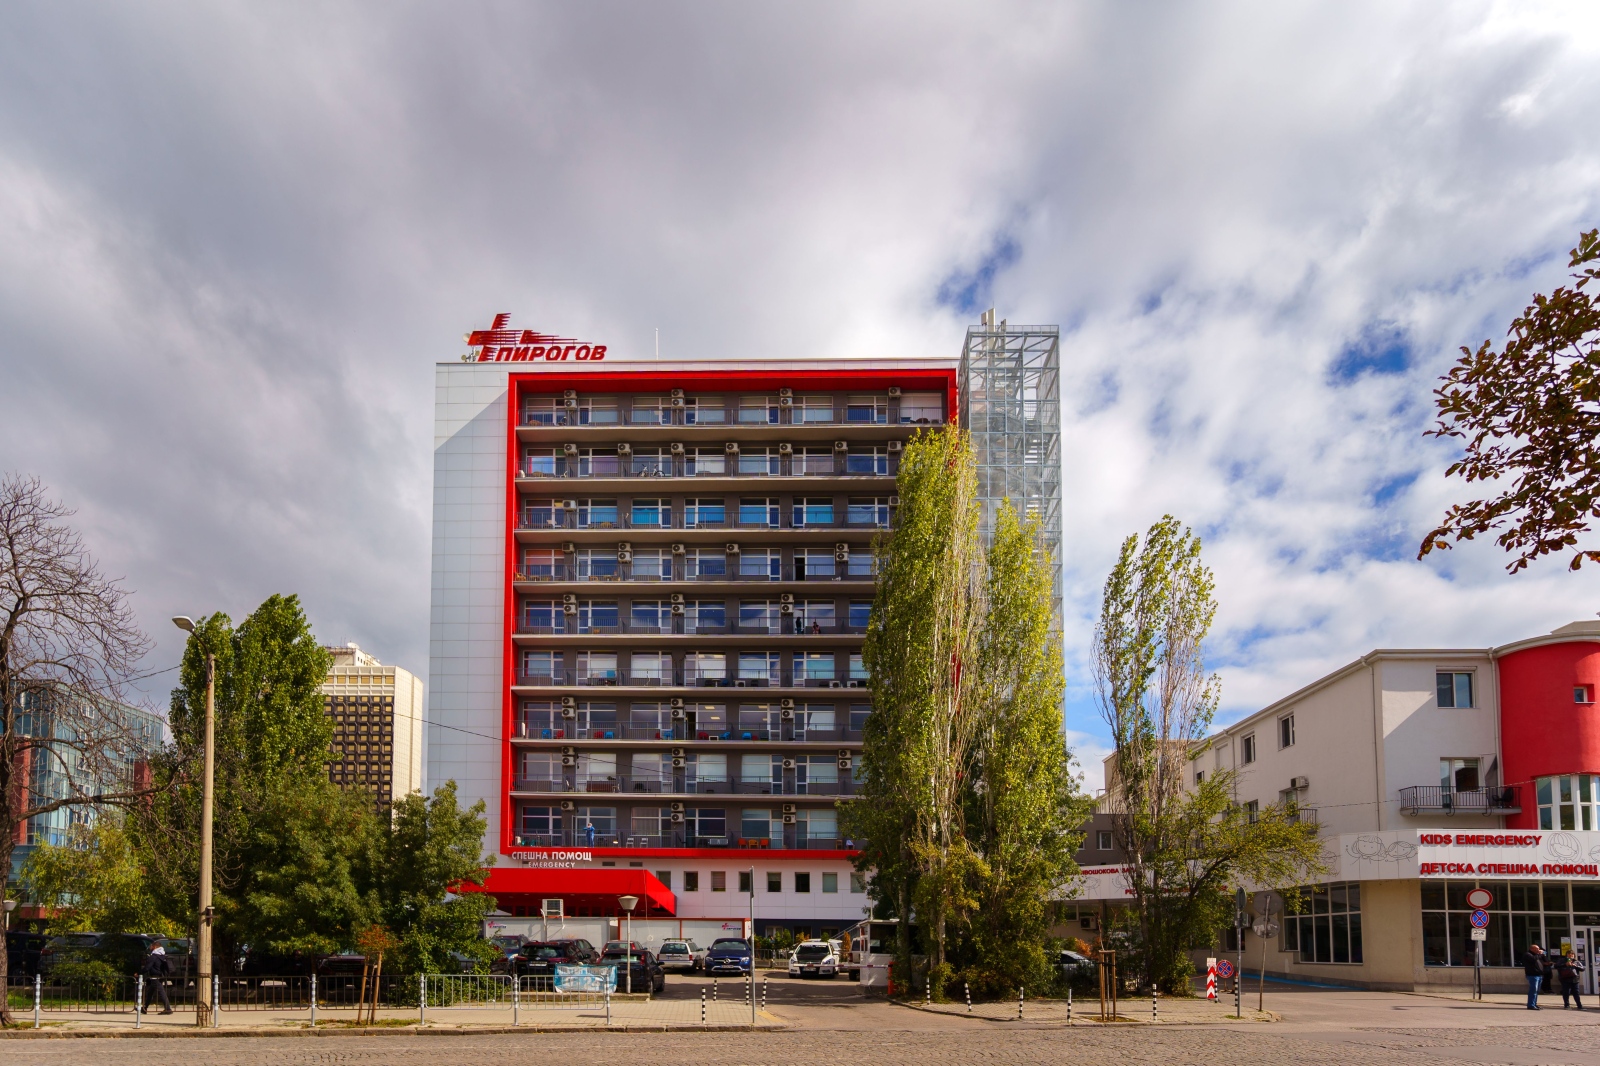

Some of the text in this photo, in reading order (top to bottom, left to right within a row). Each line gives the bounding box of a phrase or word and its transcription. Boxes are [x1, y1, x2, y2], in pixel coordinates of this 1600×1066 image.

[495, 345, 607, 361] ПИРОГОВ
[1420, 834, 1542, 845] KIDS EMERGENCY
[552, 852, 592, 861] ПОМОЩ
[1420, 863, 1598, 876] ДЕТСКА СПЕШНА ПОМОЩ
